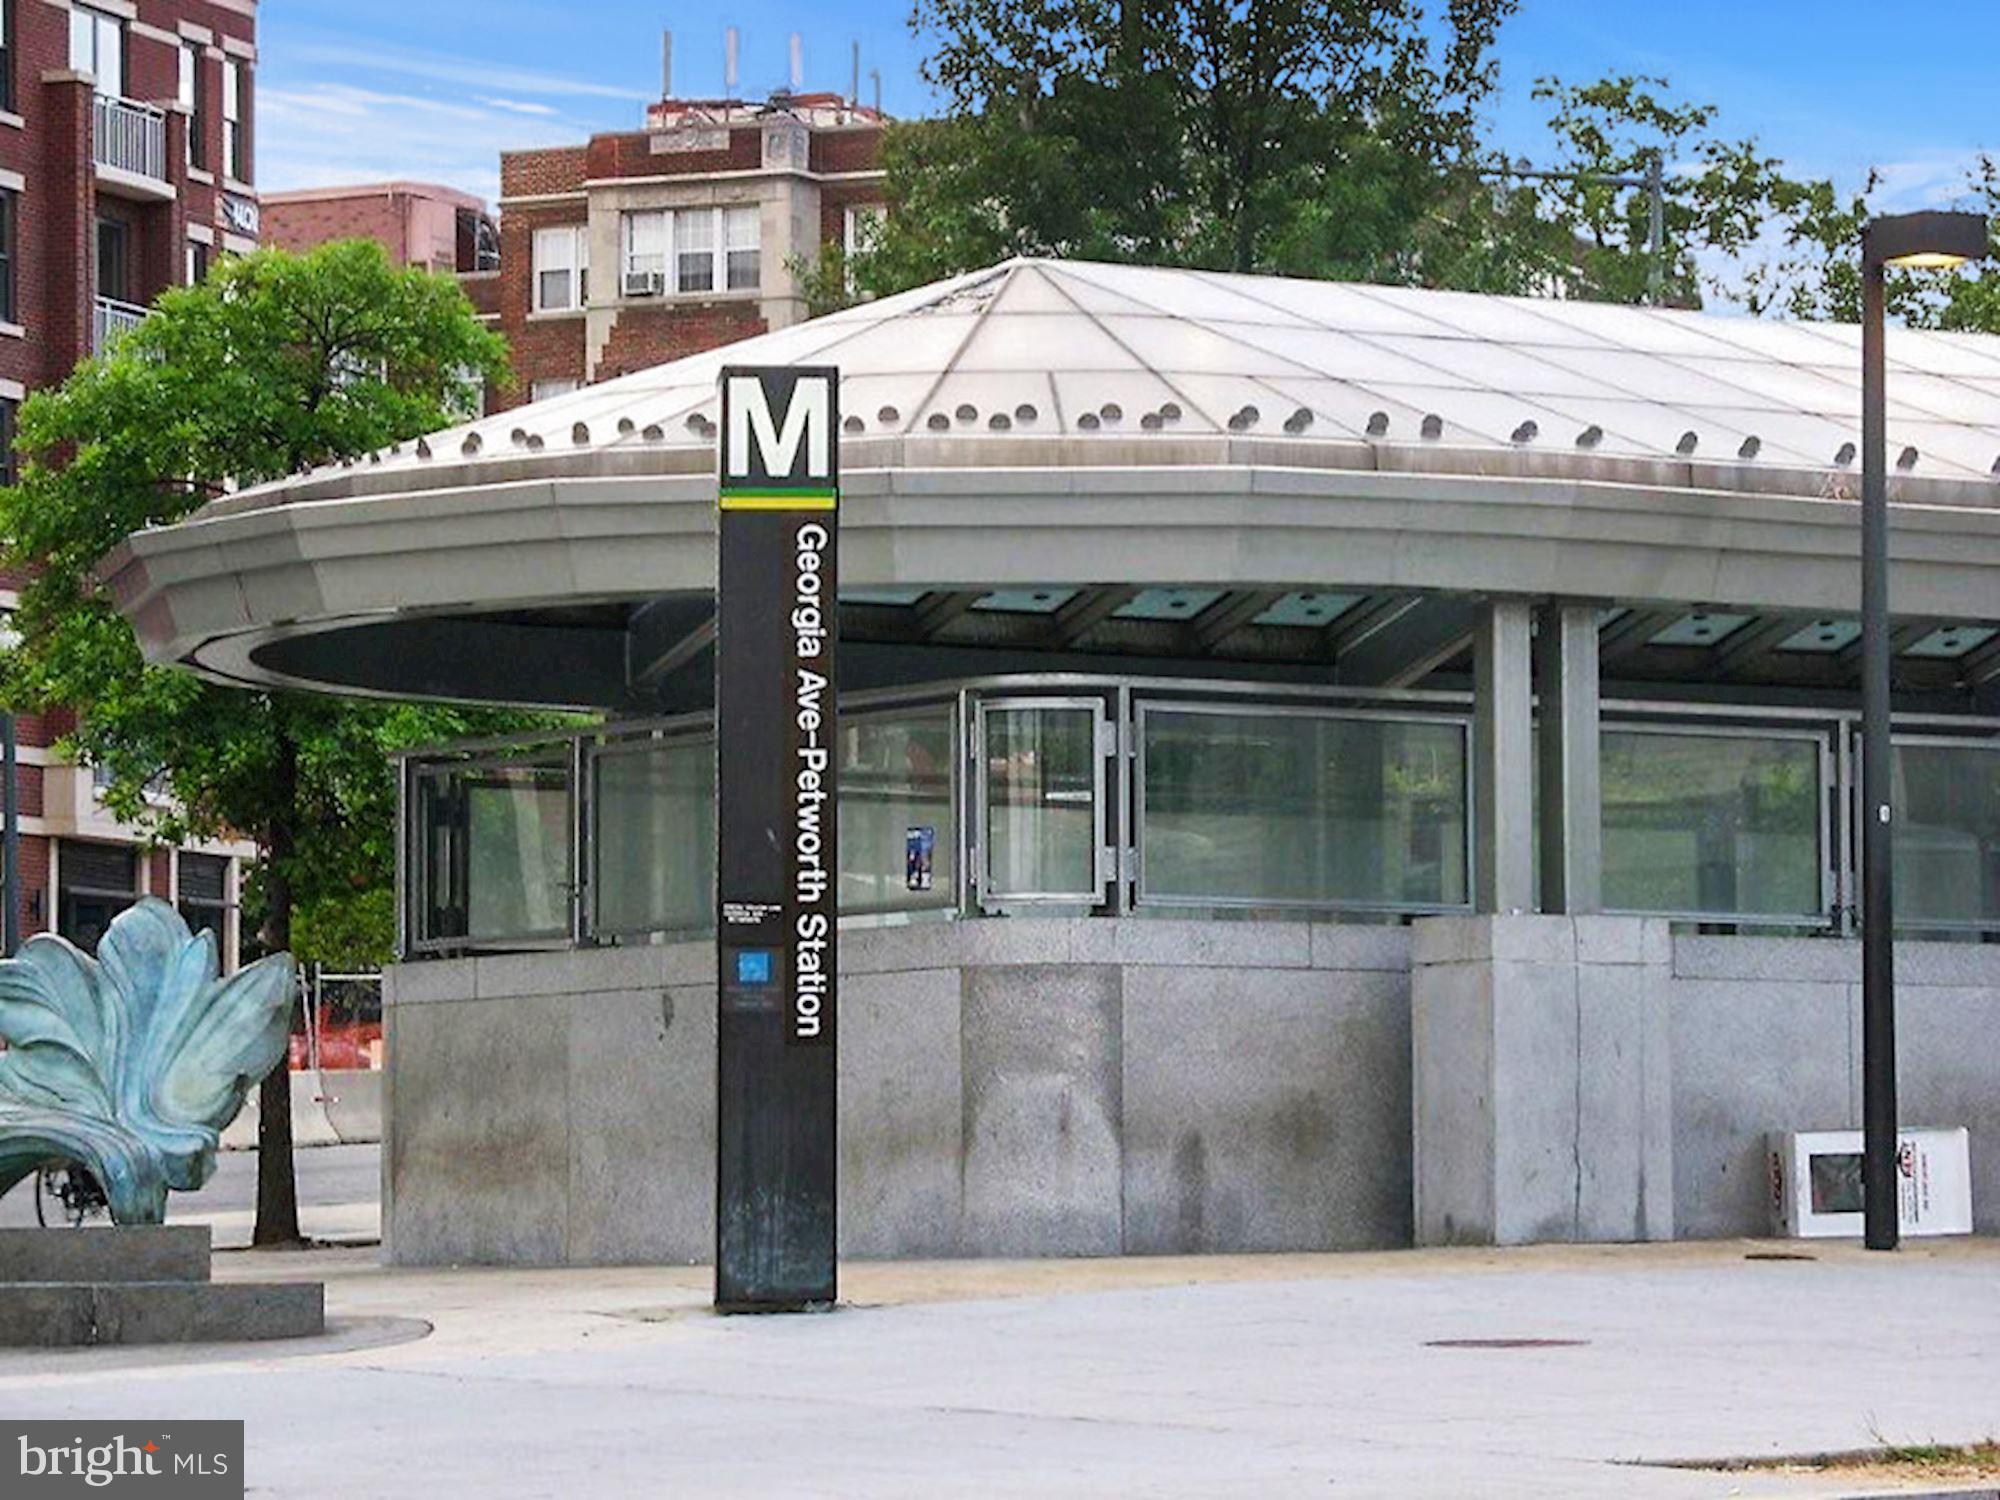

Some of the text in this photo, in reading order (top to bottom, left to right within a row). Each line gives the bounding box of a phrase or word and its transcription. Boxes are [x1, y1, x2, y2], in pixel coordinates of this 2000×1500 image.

[728, 376, 829, 478] M
[791, 523, 827, 1036] Georgia Ave-Petworth Station
